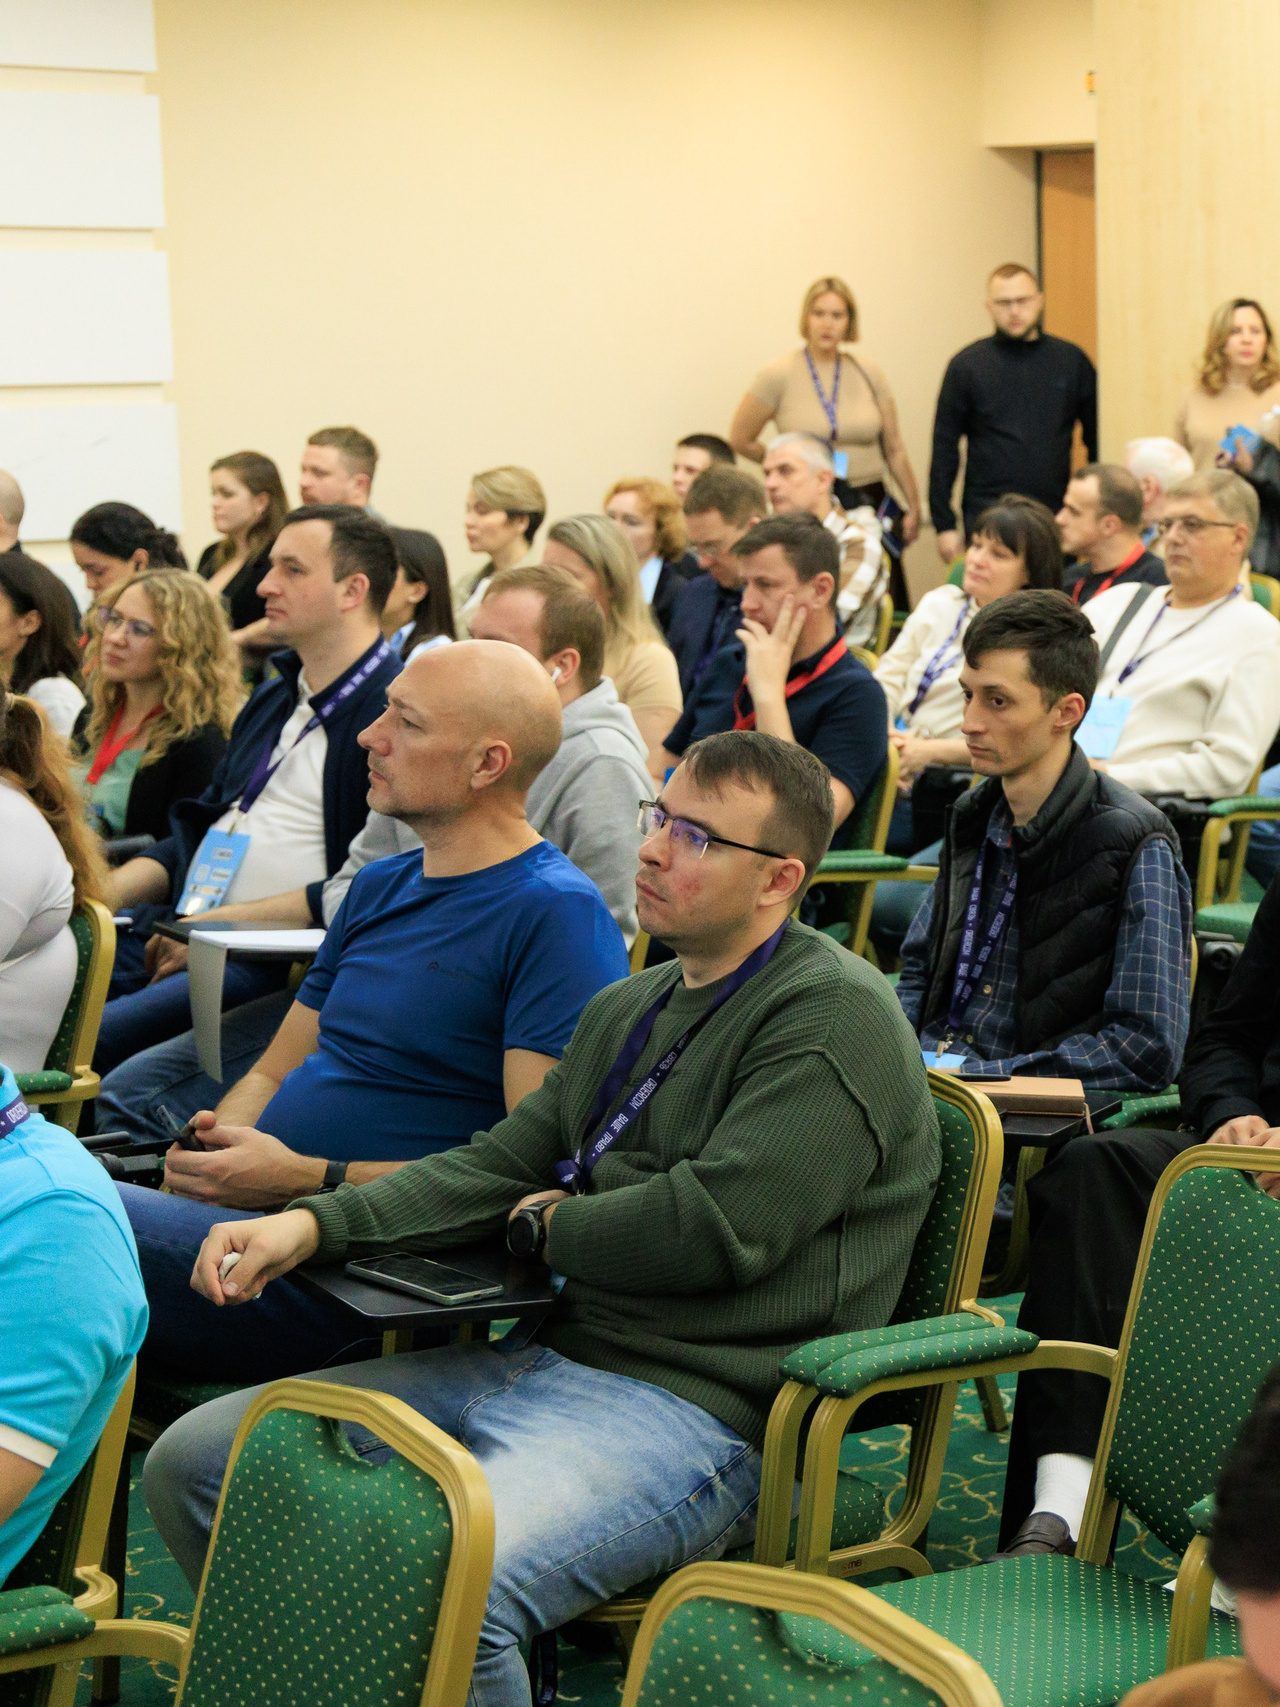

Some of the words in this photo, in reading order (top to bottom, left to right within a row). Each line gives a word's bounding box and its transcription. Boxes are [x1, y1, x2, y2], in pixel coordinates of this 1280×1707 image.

[629, 1077, 658, 1110] ORDERCOM
[610, 1113, 629, 1133] ВАШЕ
[594, 1131, 614, 1153] ПРАВО
